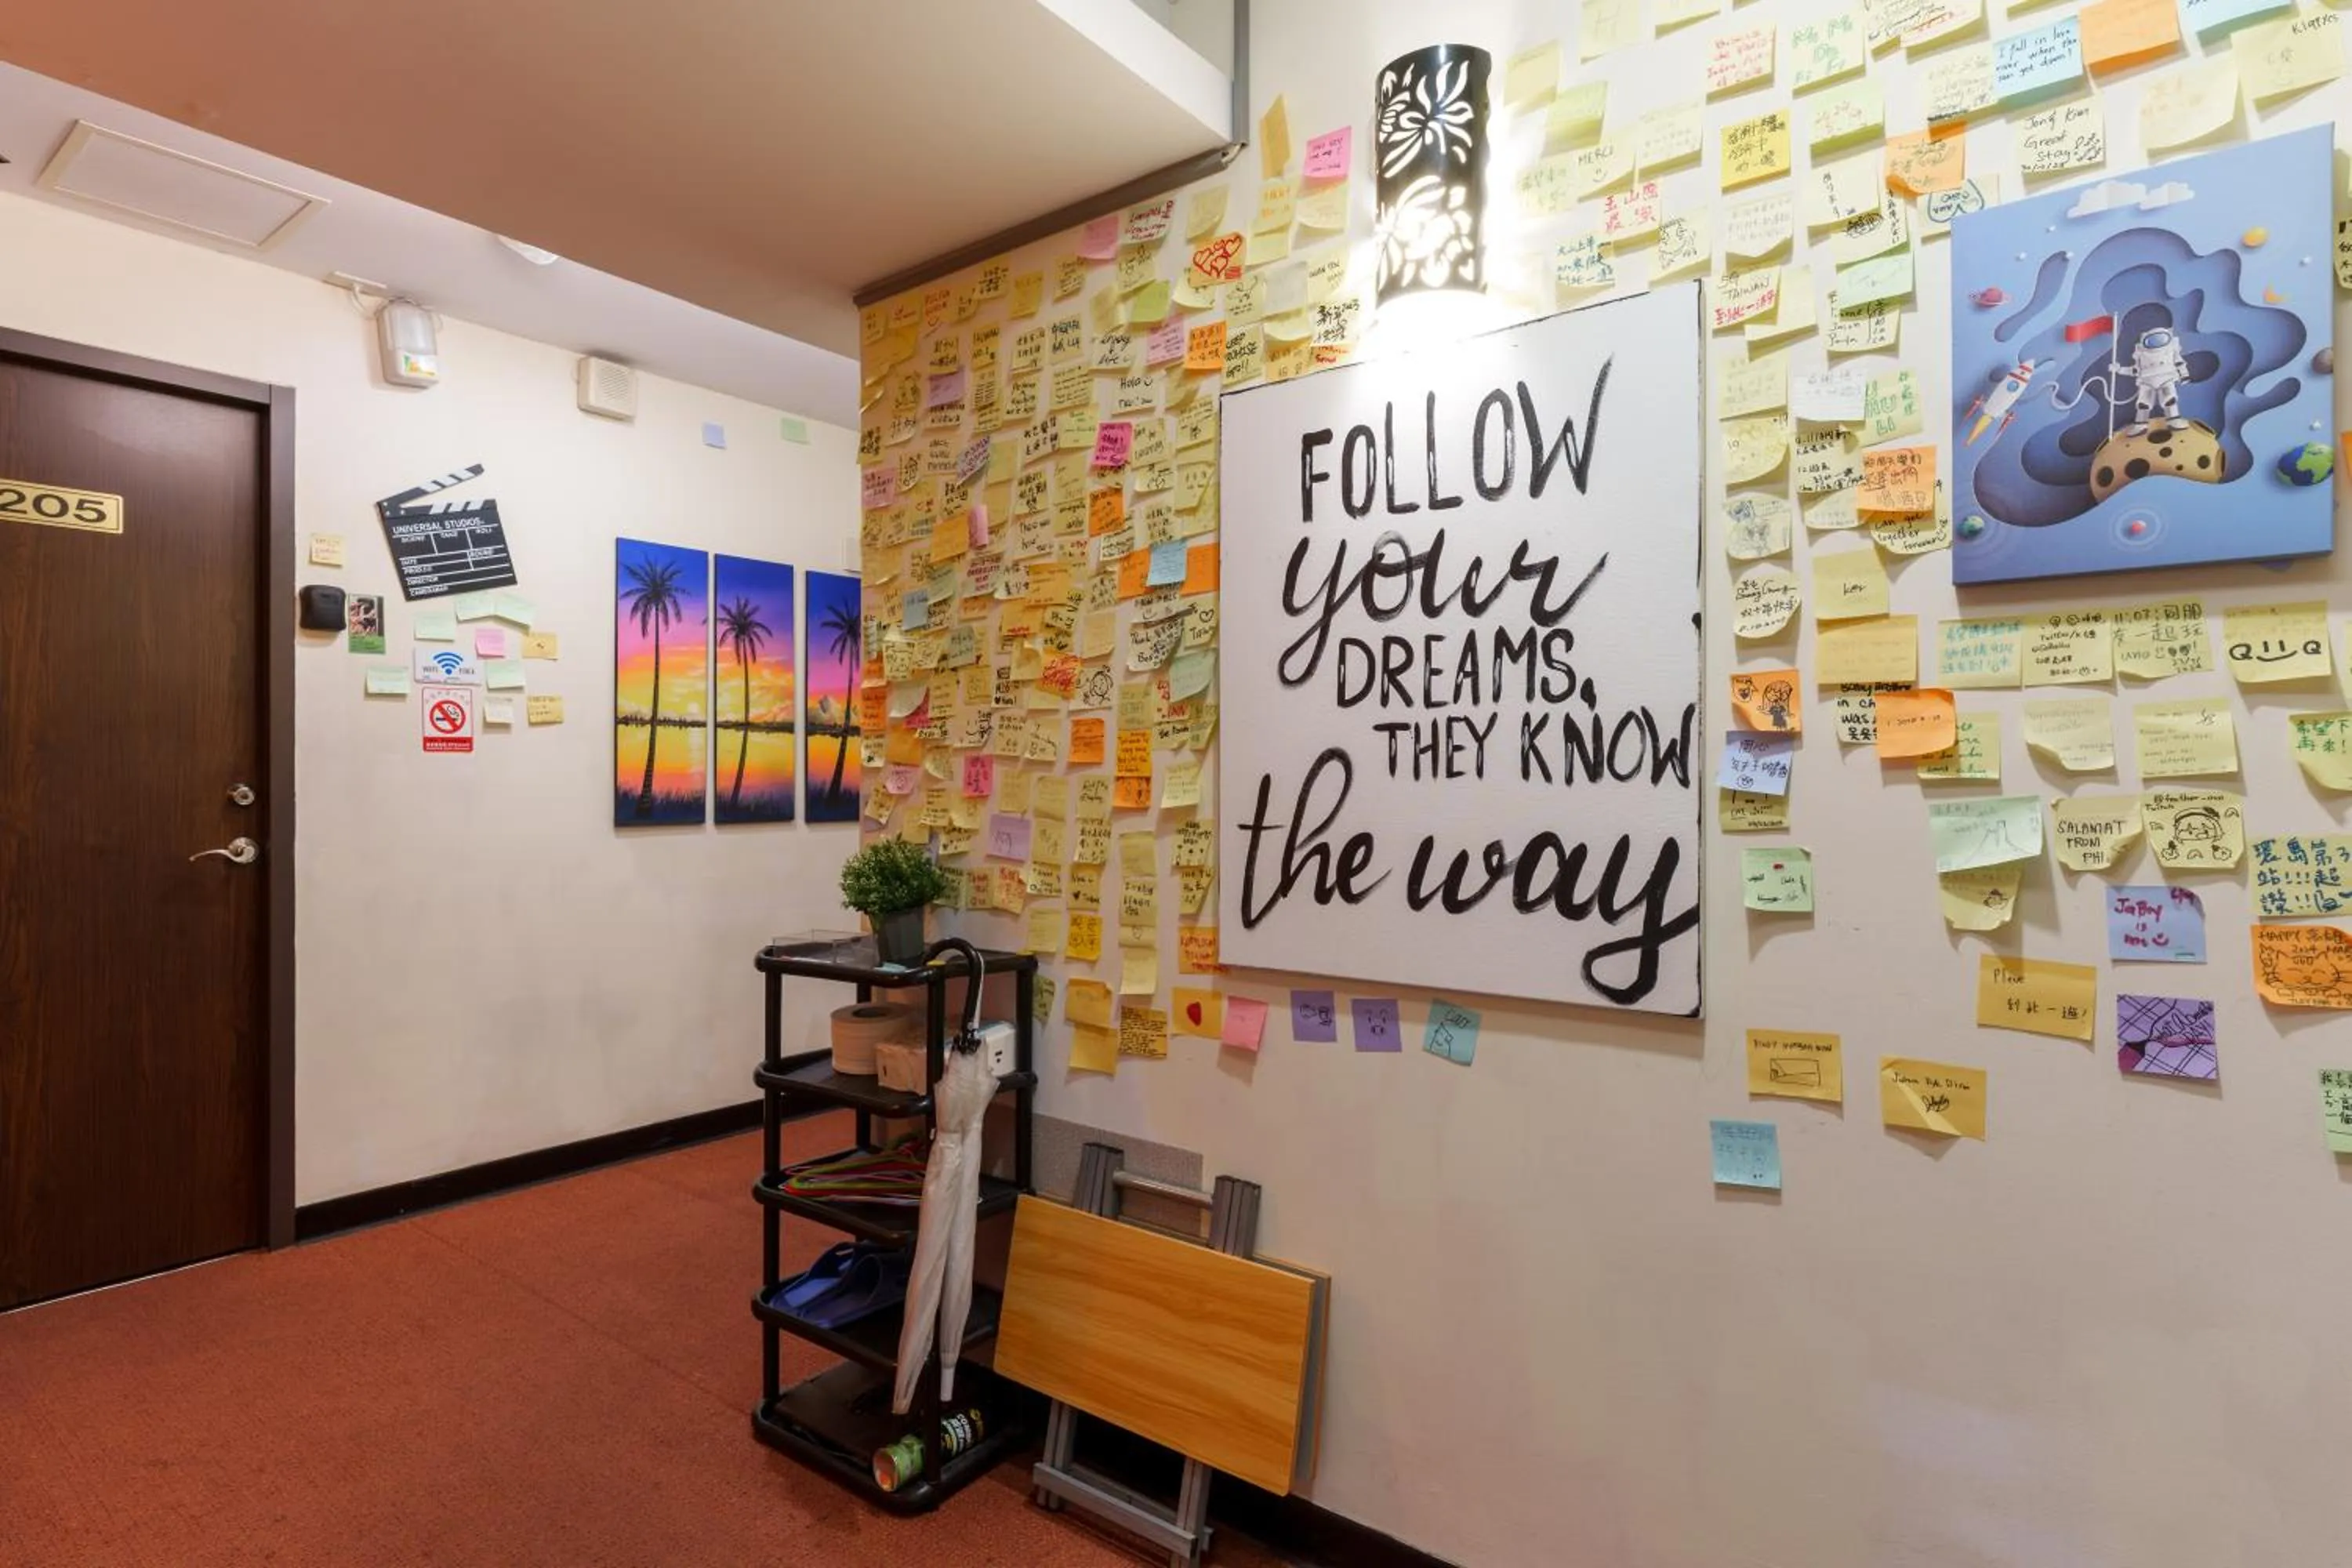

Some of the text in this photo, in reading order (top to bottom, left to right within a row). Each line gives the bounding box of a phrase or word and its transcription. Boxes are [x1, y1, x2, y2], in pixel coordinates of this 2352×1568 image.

[1301, 352, 1615, 523] FOLLOW
[0, 488, 107, 524] 205
[392, 517, 481, 535] UNIVERSAL STUDIOS
[1278, 527, 1610, 689] your
[1373, 710, 1498, 782] THEY
[1520, 702, 1696, 789] KNOW
[1237, 746, 1700, 1005] the way
